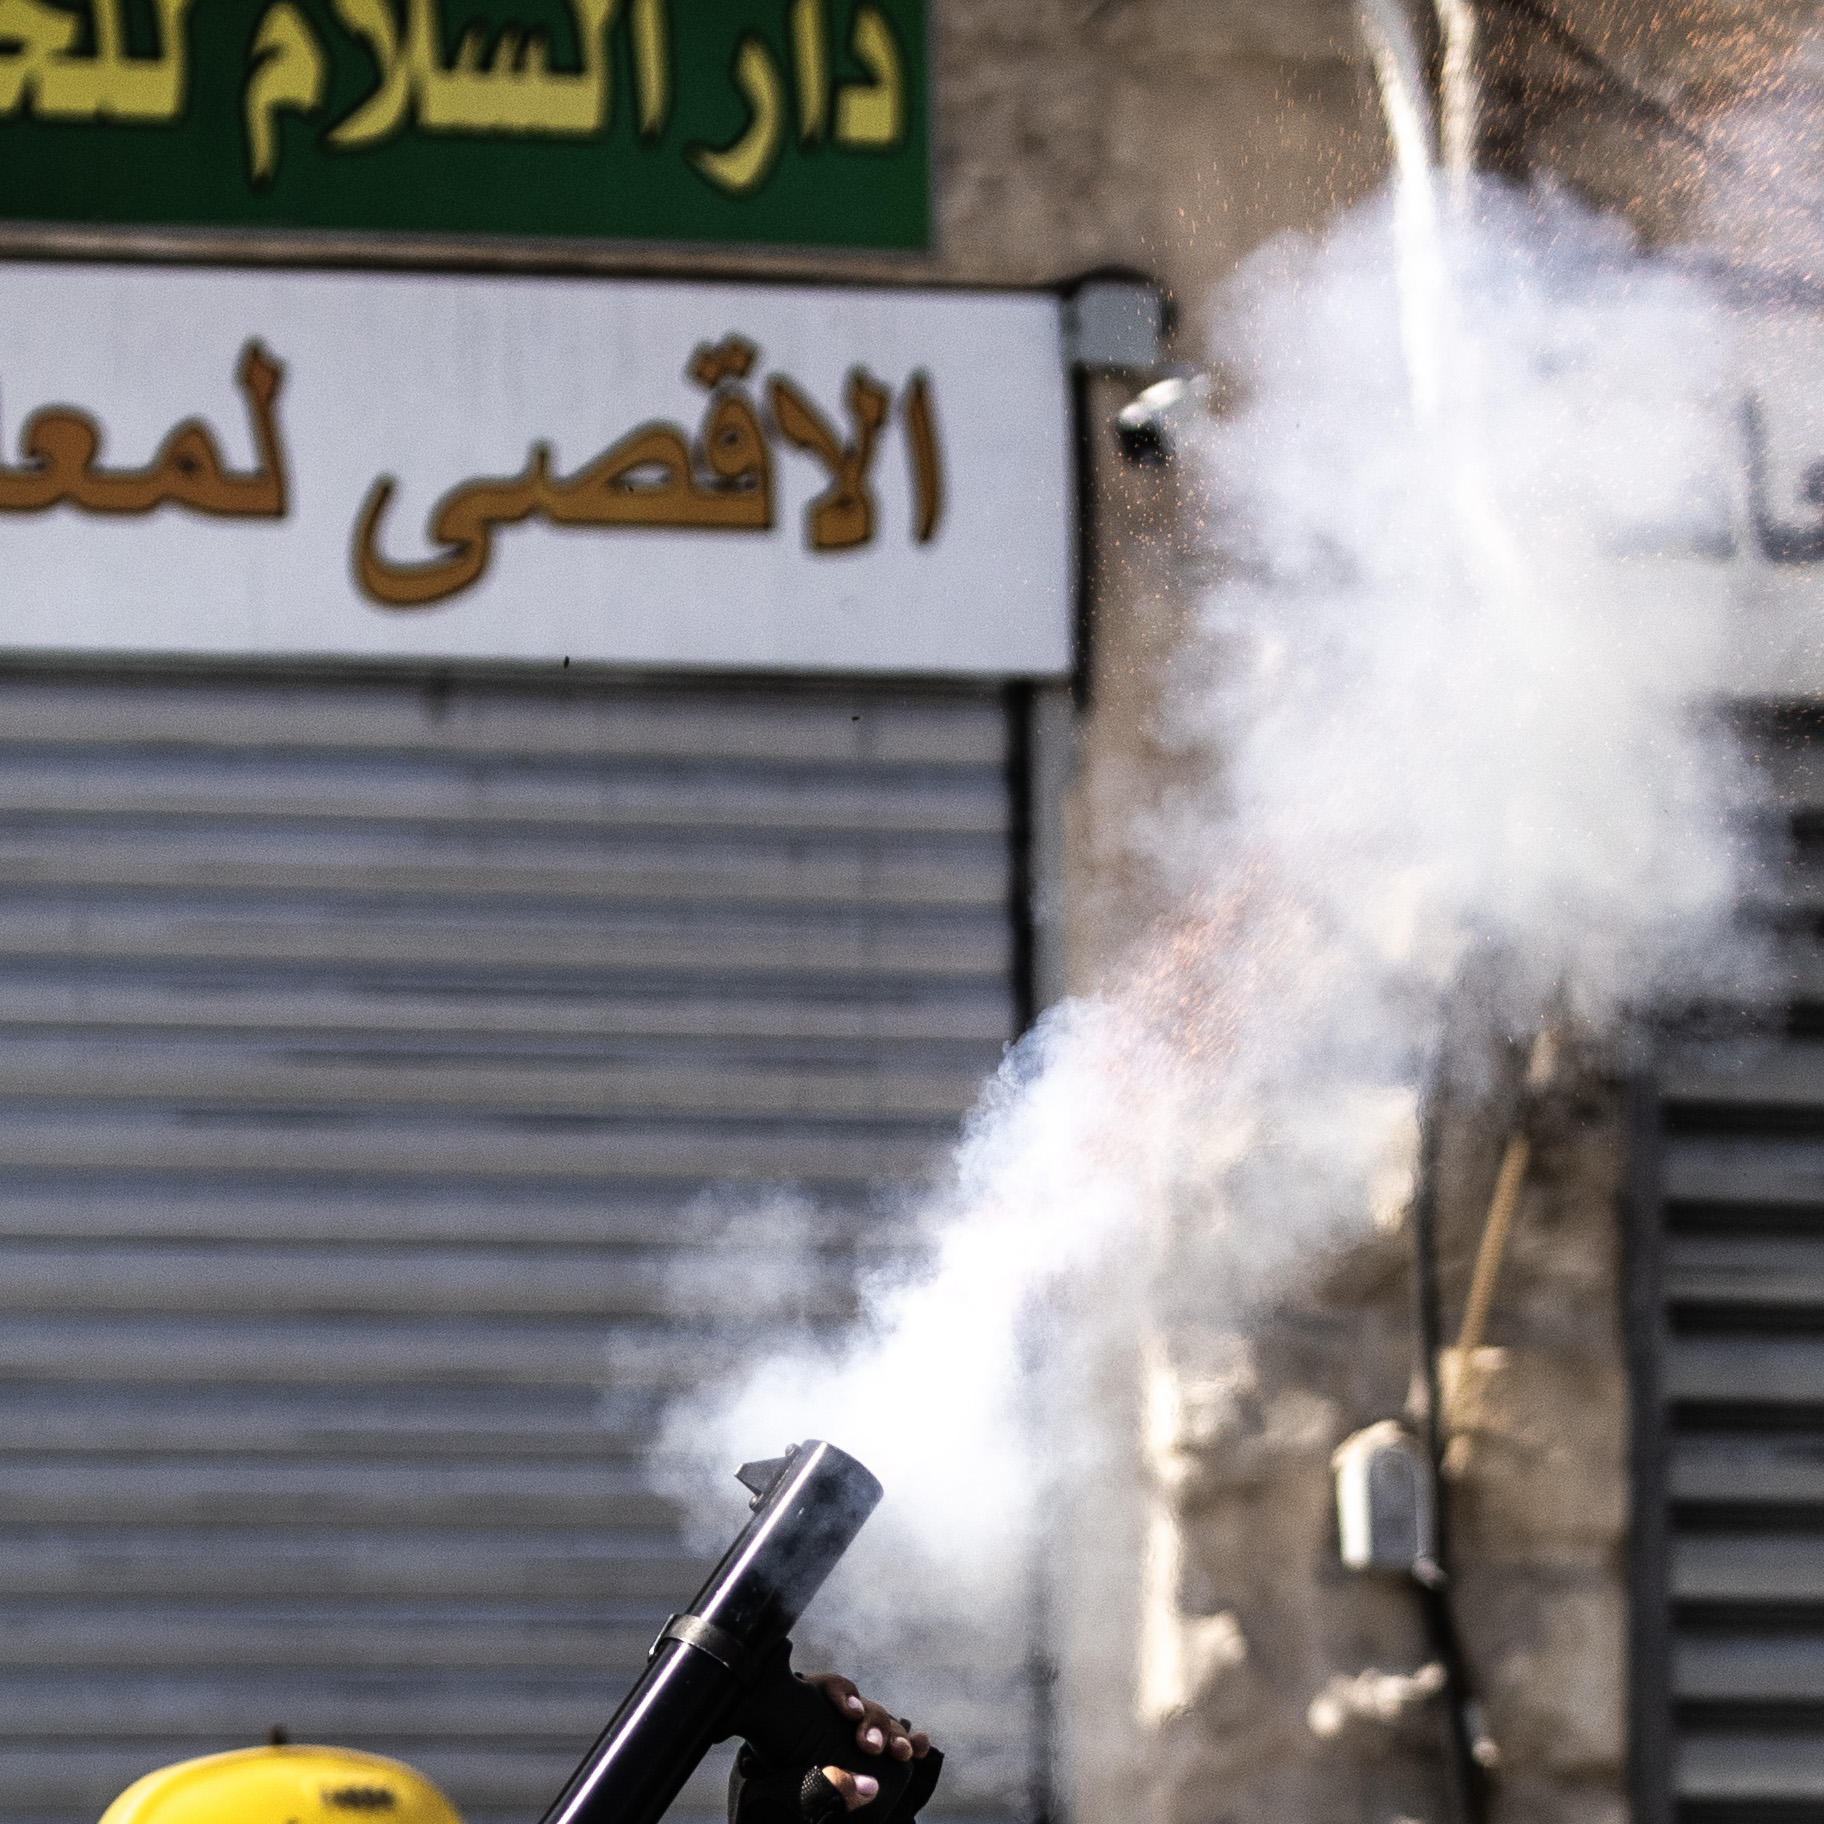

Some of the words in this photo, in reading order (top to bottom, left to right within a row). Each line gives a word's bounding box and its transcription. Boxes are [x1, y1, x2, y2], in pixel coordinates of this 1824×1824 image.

[242, 0, 668, 189] السلام
[690, 0, 902, 193] دار
[351, 333, 944, 608] الاقصى
